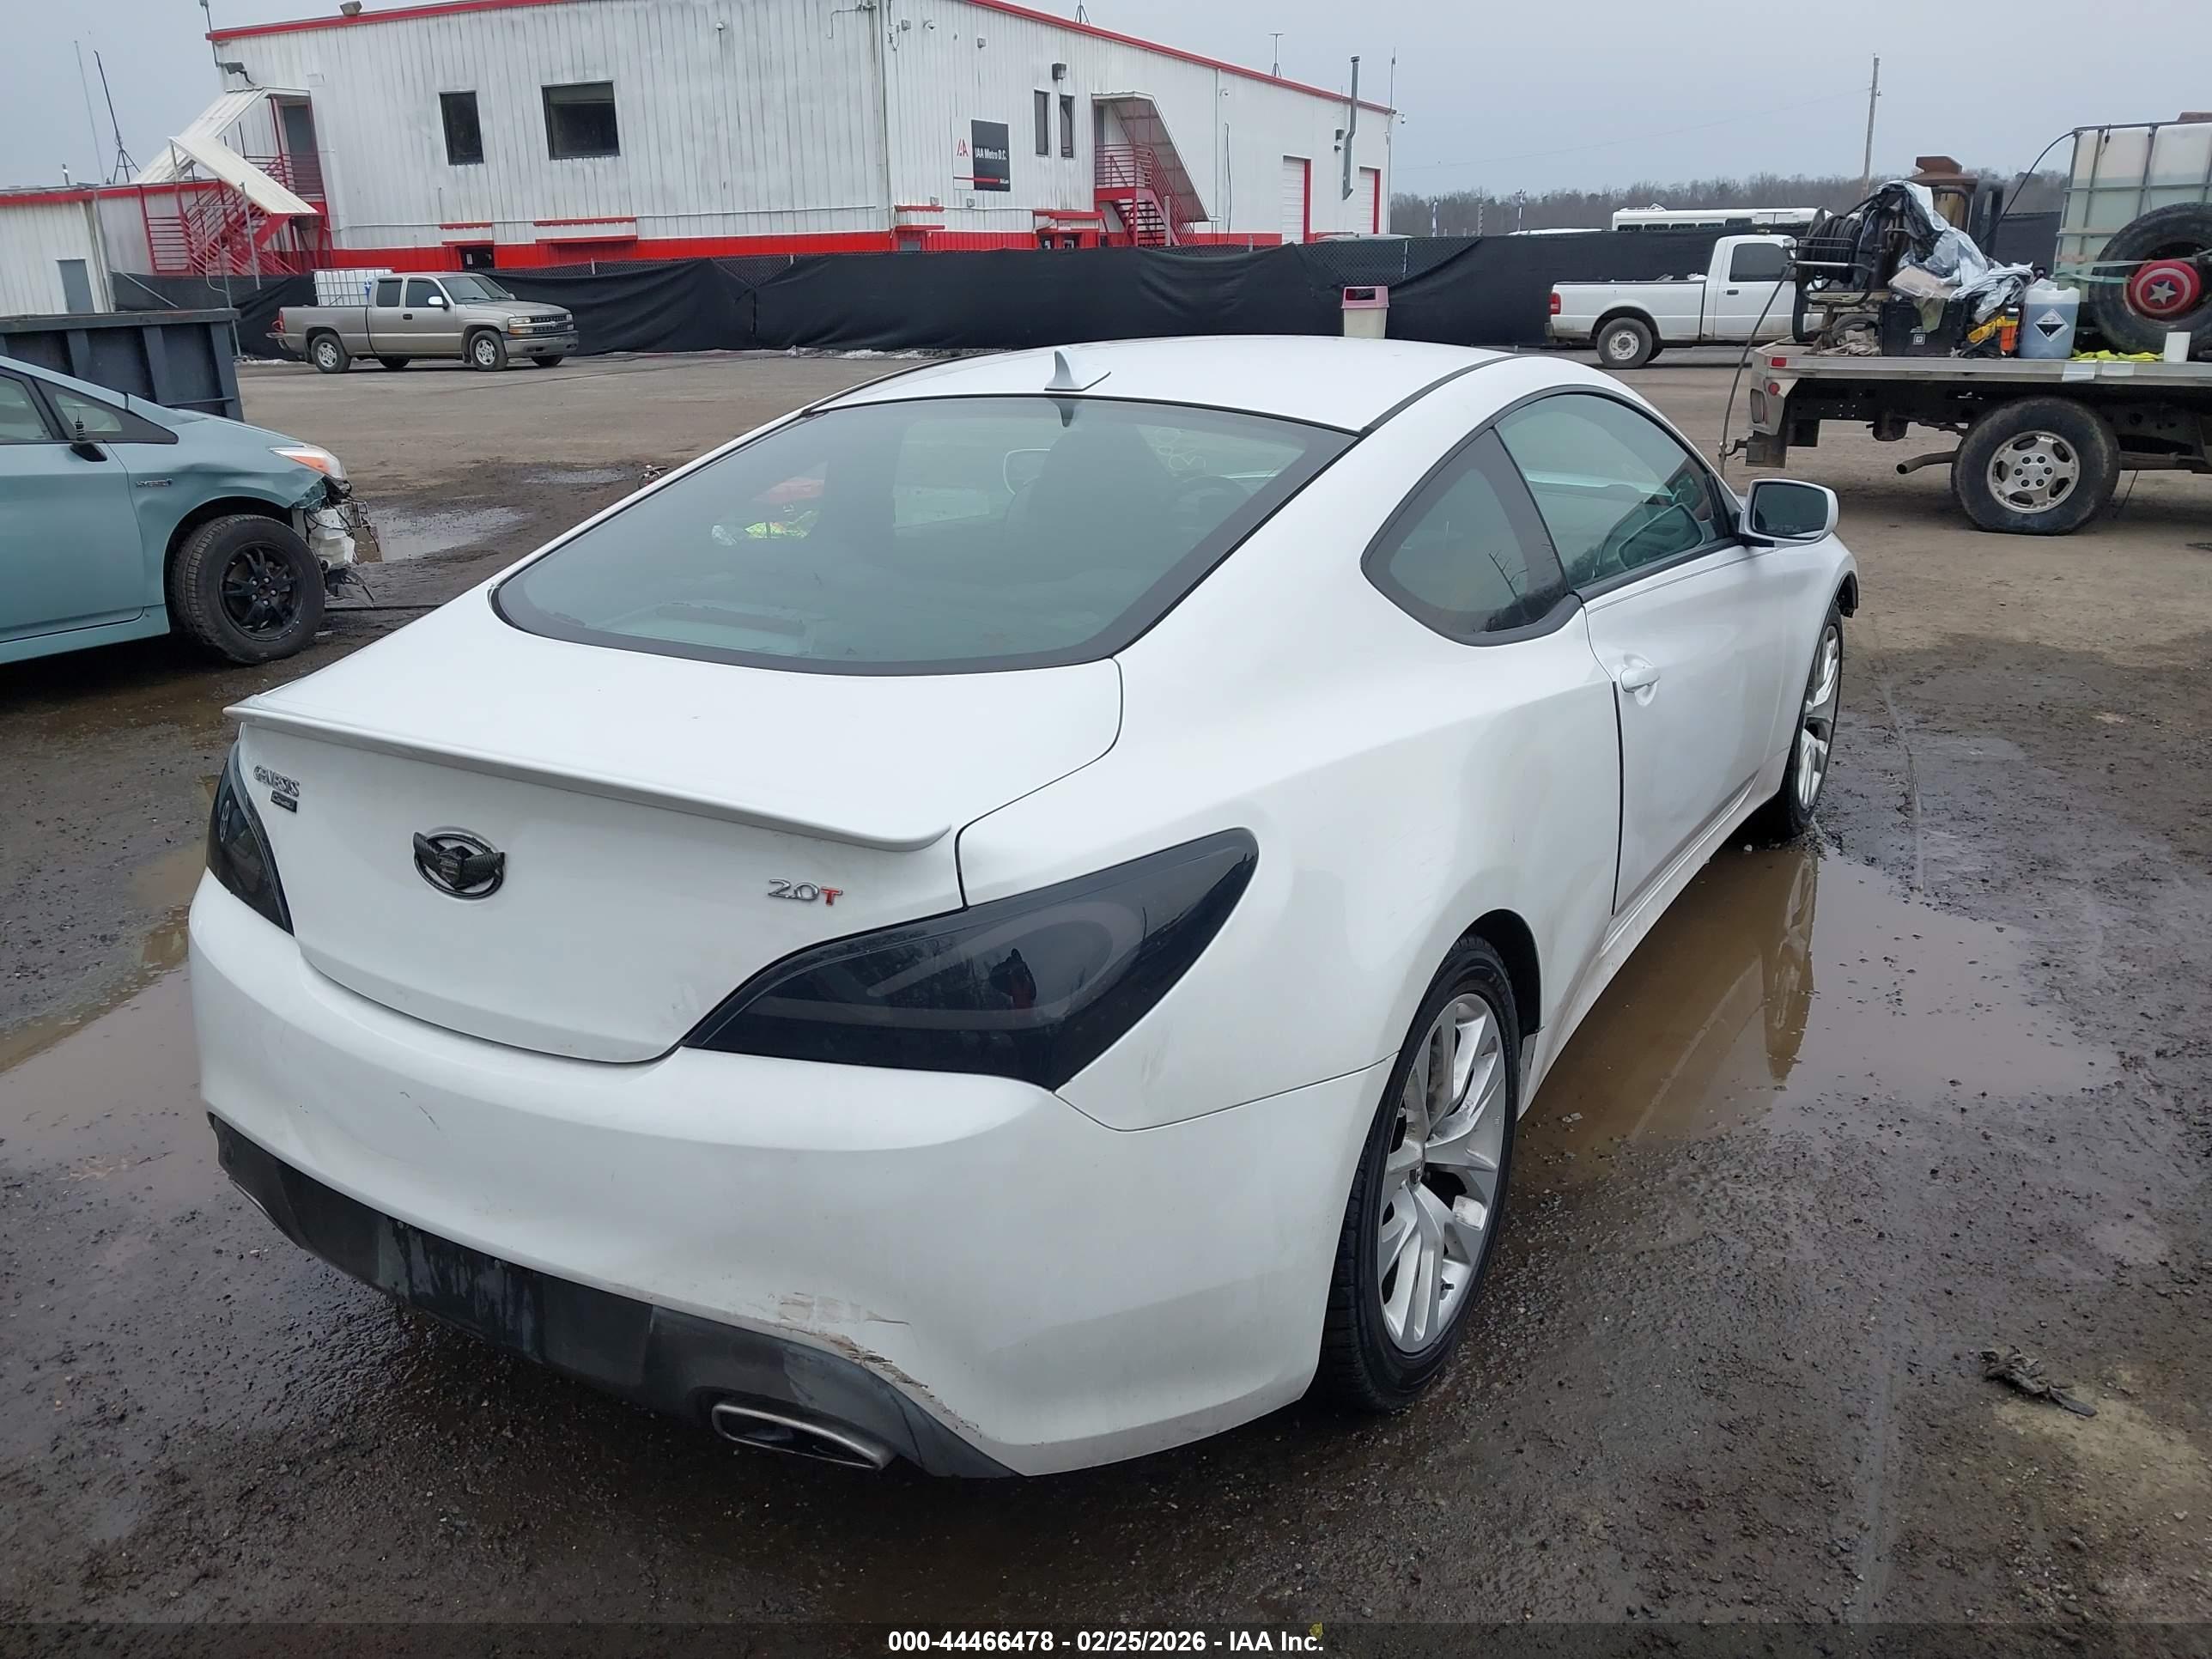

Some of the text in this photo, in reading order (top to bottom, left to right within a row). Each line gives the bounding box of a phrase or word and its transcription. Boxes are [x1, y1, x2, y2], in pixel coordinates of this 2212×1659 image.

[975, 147, 1007, 161] IAA Metro D.C.
[253, 764, 300, 798] GENESIS
[768, 878, 843, 907] 2.0T
